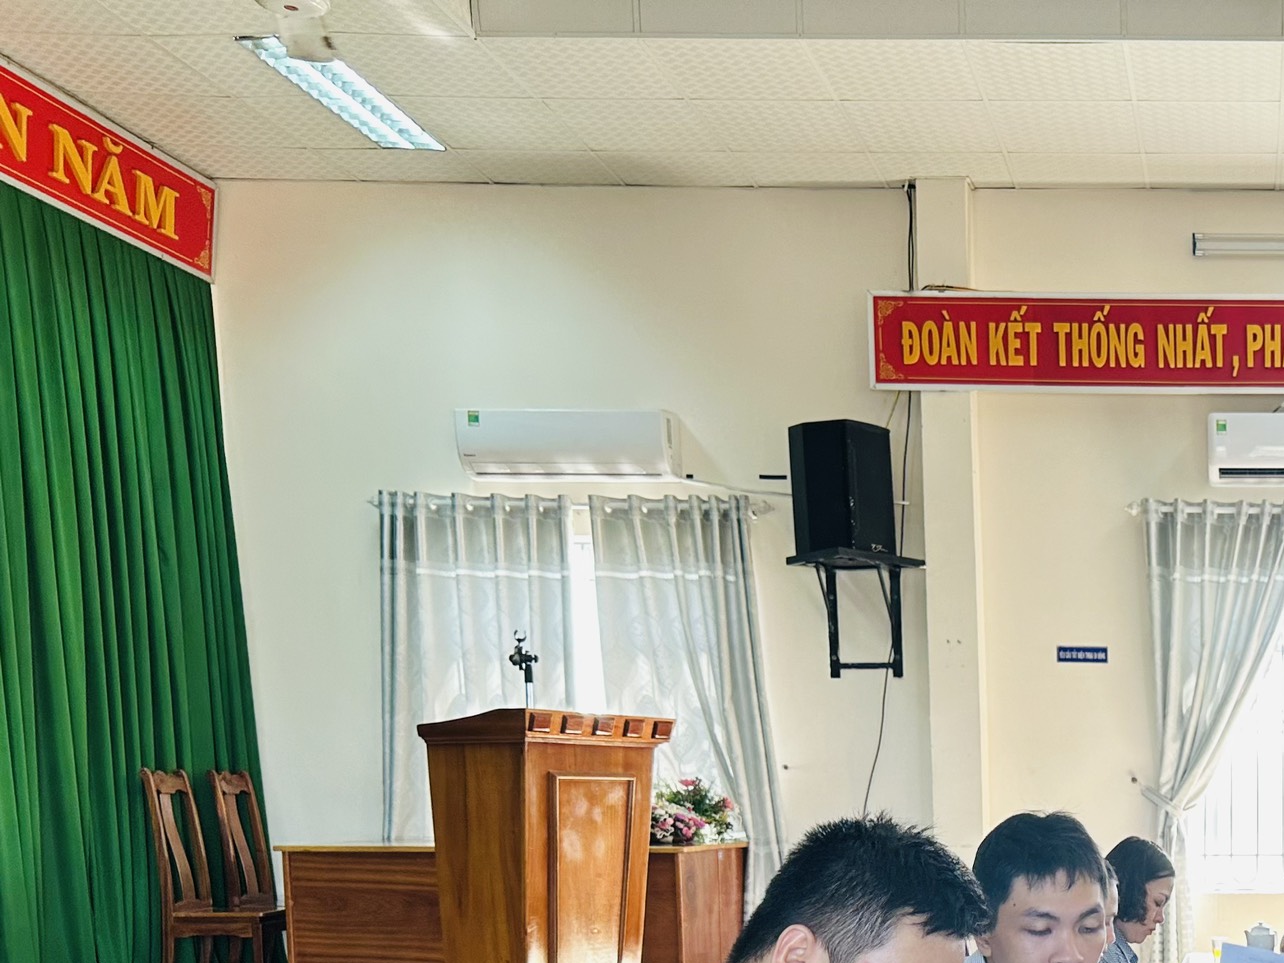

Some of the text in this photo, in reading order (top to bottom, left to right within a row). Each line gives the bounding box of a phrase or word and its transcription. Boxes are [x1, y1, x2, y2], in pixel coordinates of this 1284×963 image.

[48, 123, 180, 240] NĂM
[901, 310, 978, 366] ĐOÀN
[988, 306, 1041, 366] KẾT
[1053, 306, 1145, 368] THỐNG
